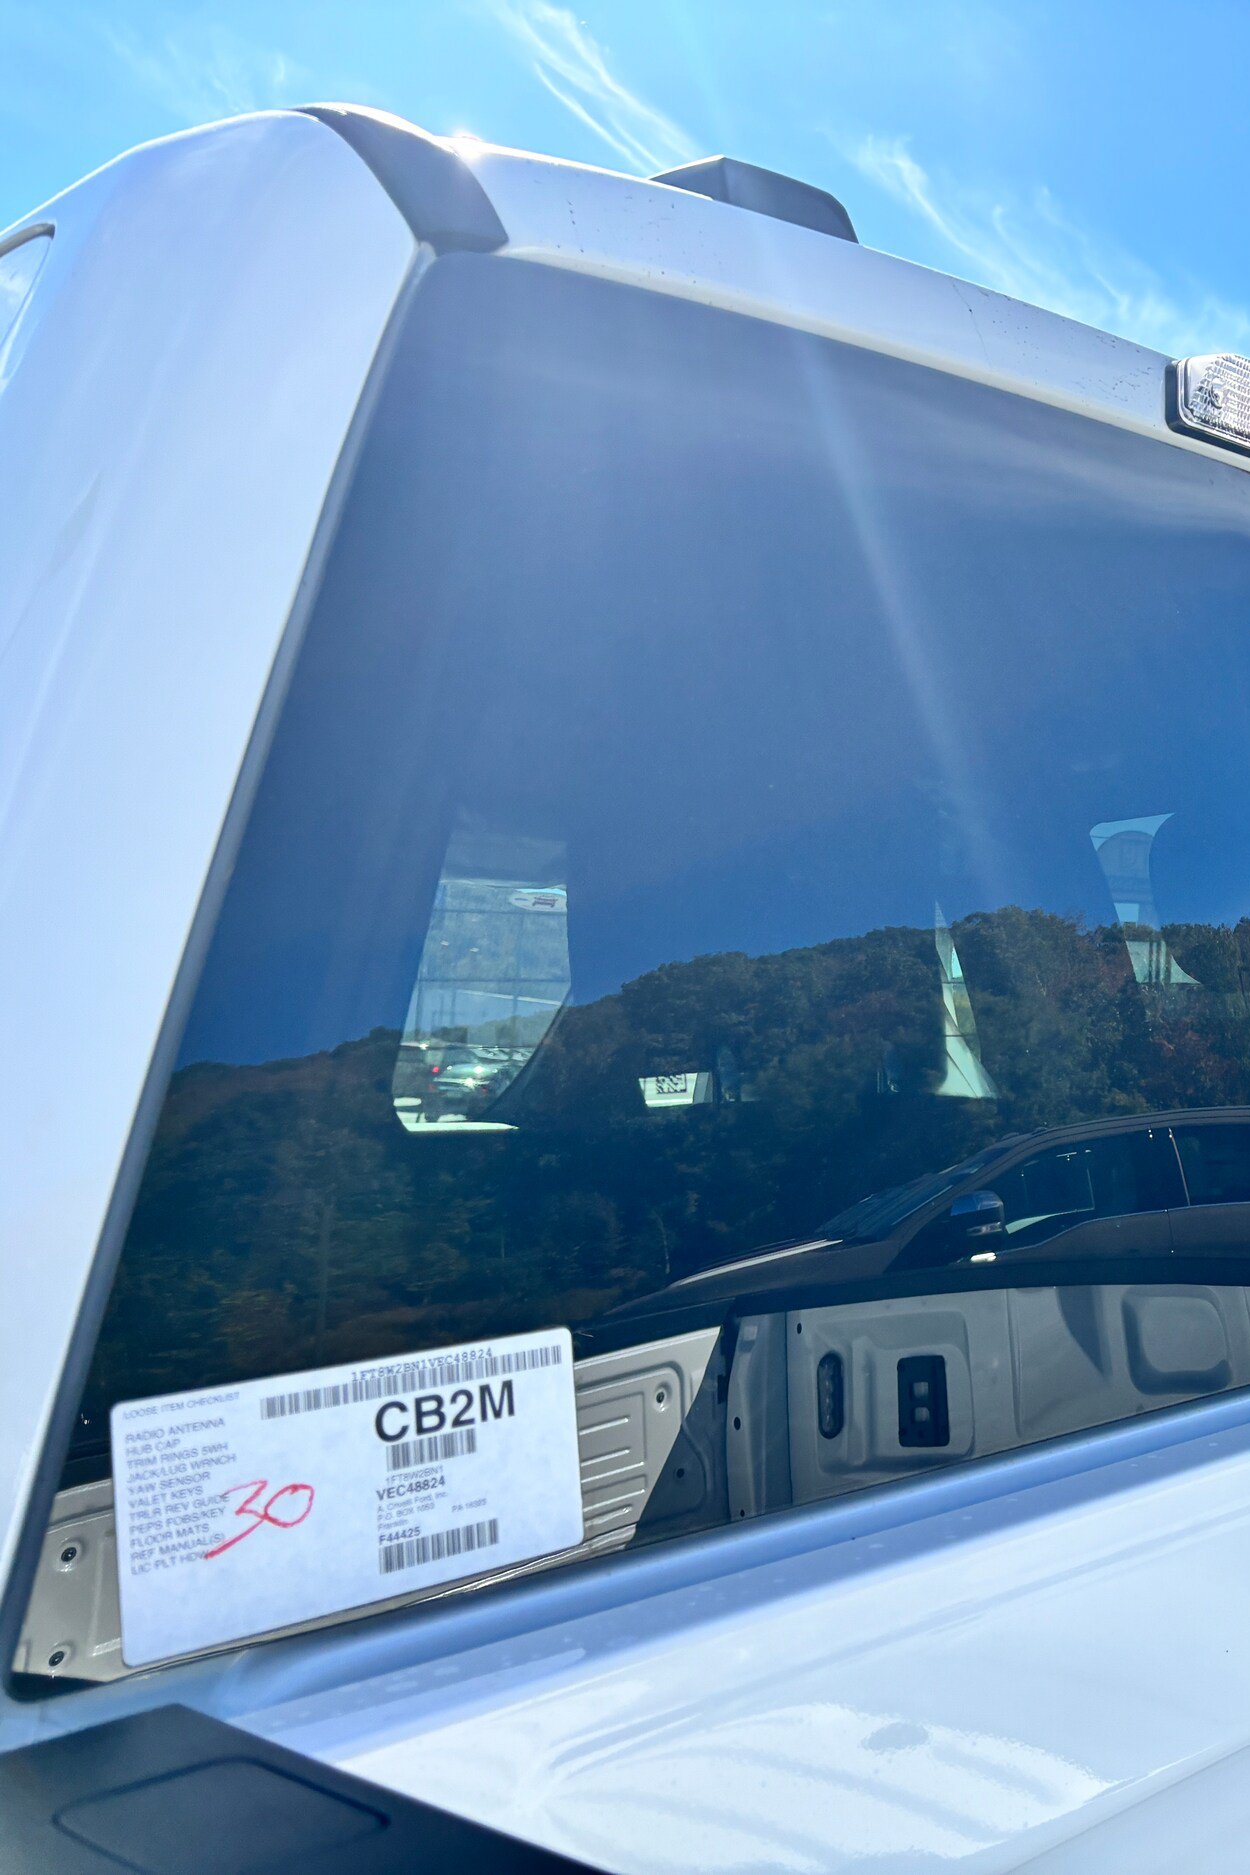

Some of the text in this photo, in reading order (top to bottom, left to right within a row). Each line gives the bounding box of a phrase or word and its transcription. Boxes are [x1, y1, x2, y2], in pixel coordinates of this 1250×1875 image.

[122, 1391, 240, 1420] LOOSE ITEM CHECKLIST
[375, 1379, 515, 1443] CB2M
[126, 1417, 225, 1443] RADIO ANTENNA
[126, 1438, 180, 1457] HUB CAP
[127, 1456, 157, 1469] TRIM
[160, 1448, 198, 1462] RINGS
[160, 1471, 210, 1490] SENSOR
[376, 1475, 446, 1500] VEC48824
[128, 1486, 203, 1508] VALET KEYS
[193, 1494, 230, 1508] GUIDE
[130, 1523, 209, 1548] FLOOR MATS
[159, 1533, 224, 1555] MANUAL(S)
[379, 1526, 421, 1544] F44425
